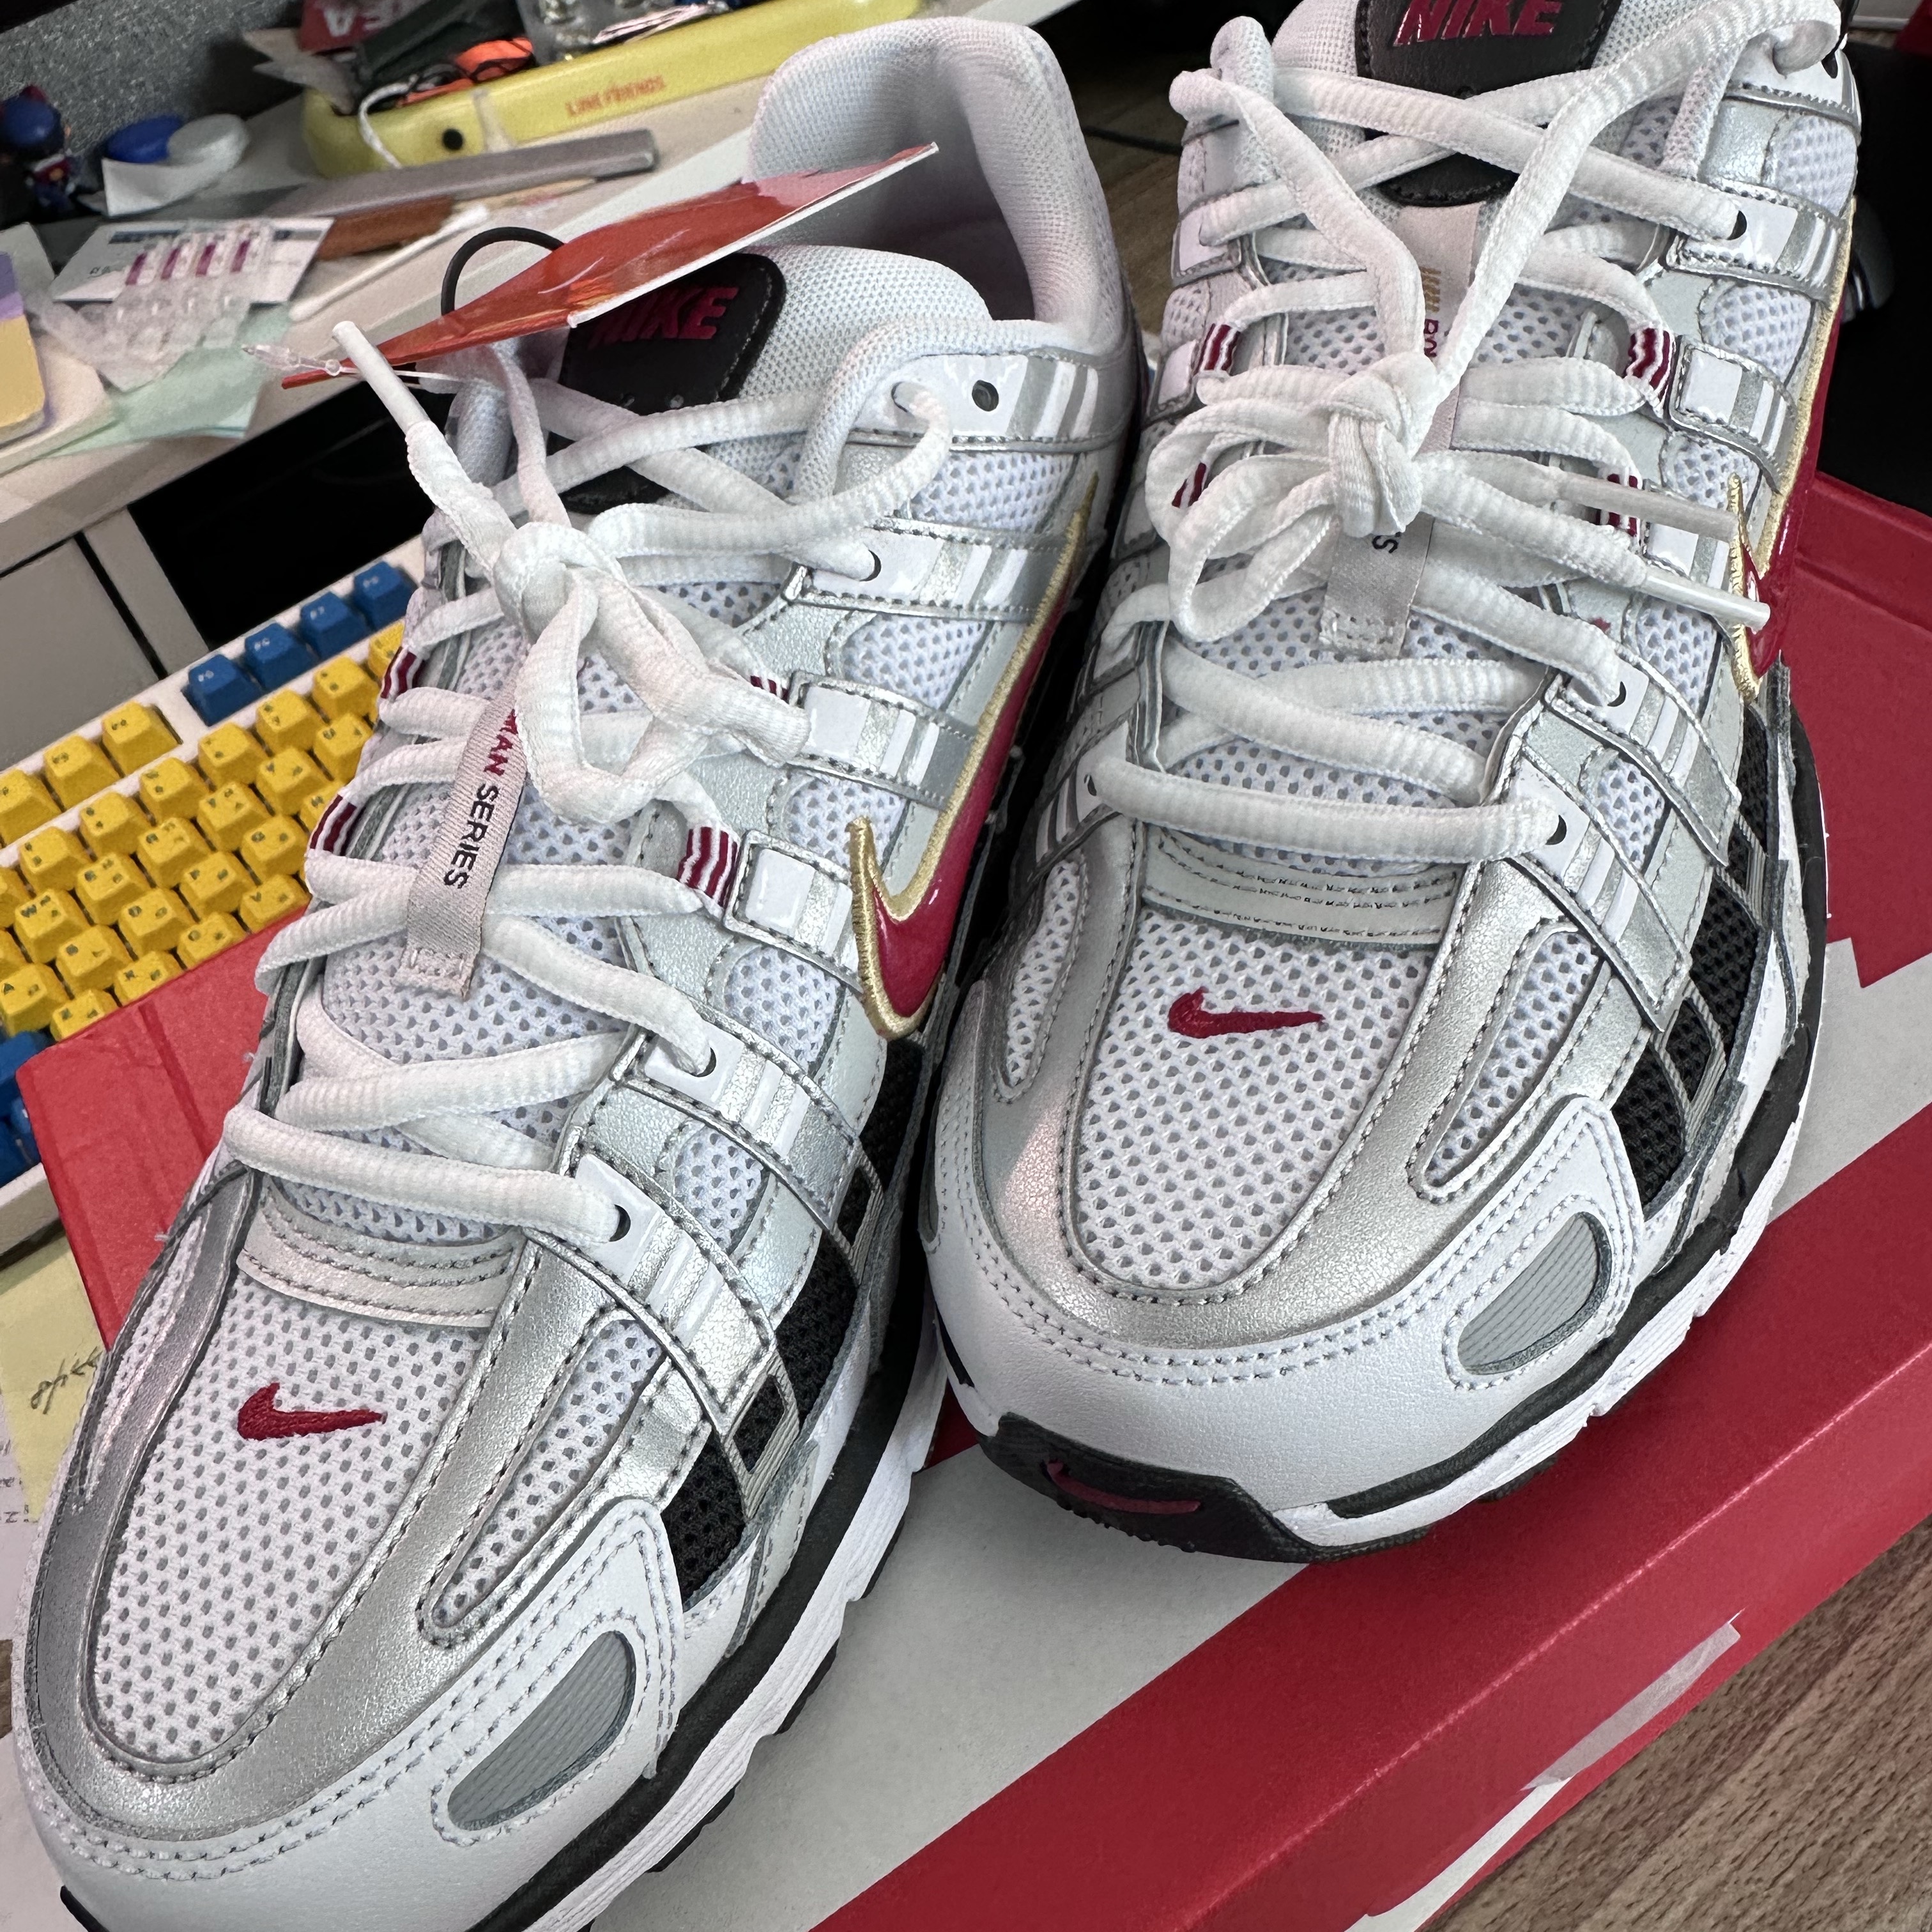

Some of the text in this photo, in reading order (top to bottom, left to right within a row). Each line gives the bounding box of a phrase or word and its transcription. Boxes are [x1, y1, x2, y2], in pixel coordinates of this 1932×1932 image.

[1393, 0, 1563, 47] NIKE
[587, 285, 739, 349] NIKE
[443, 783, 500, 889] SERIES
